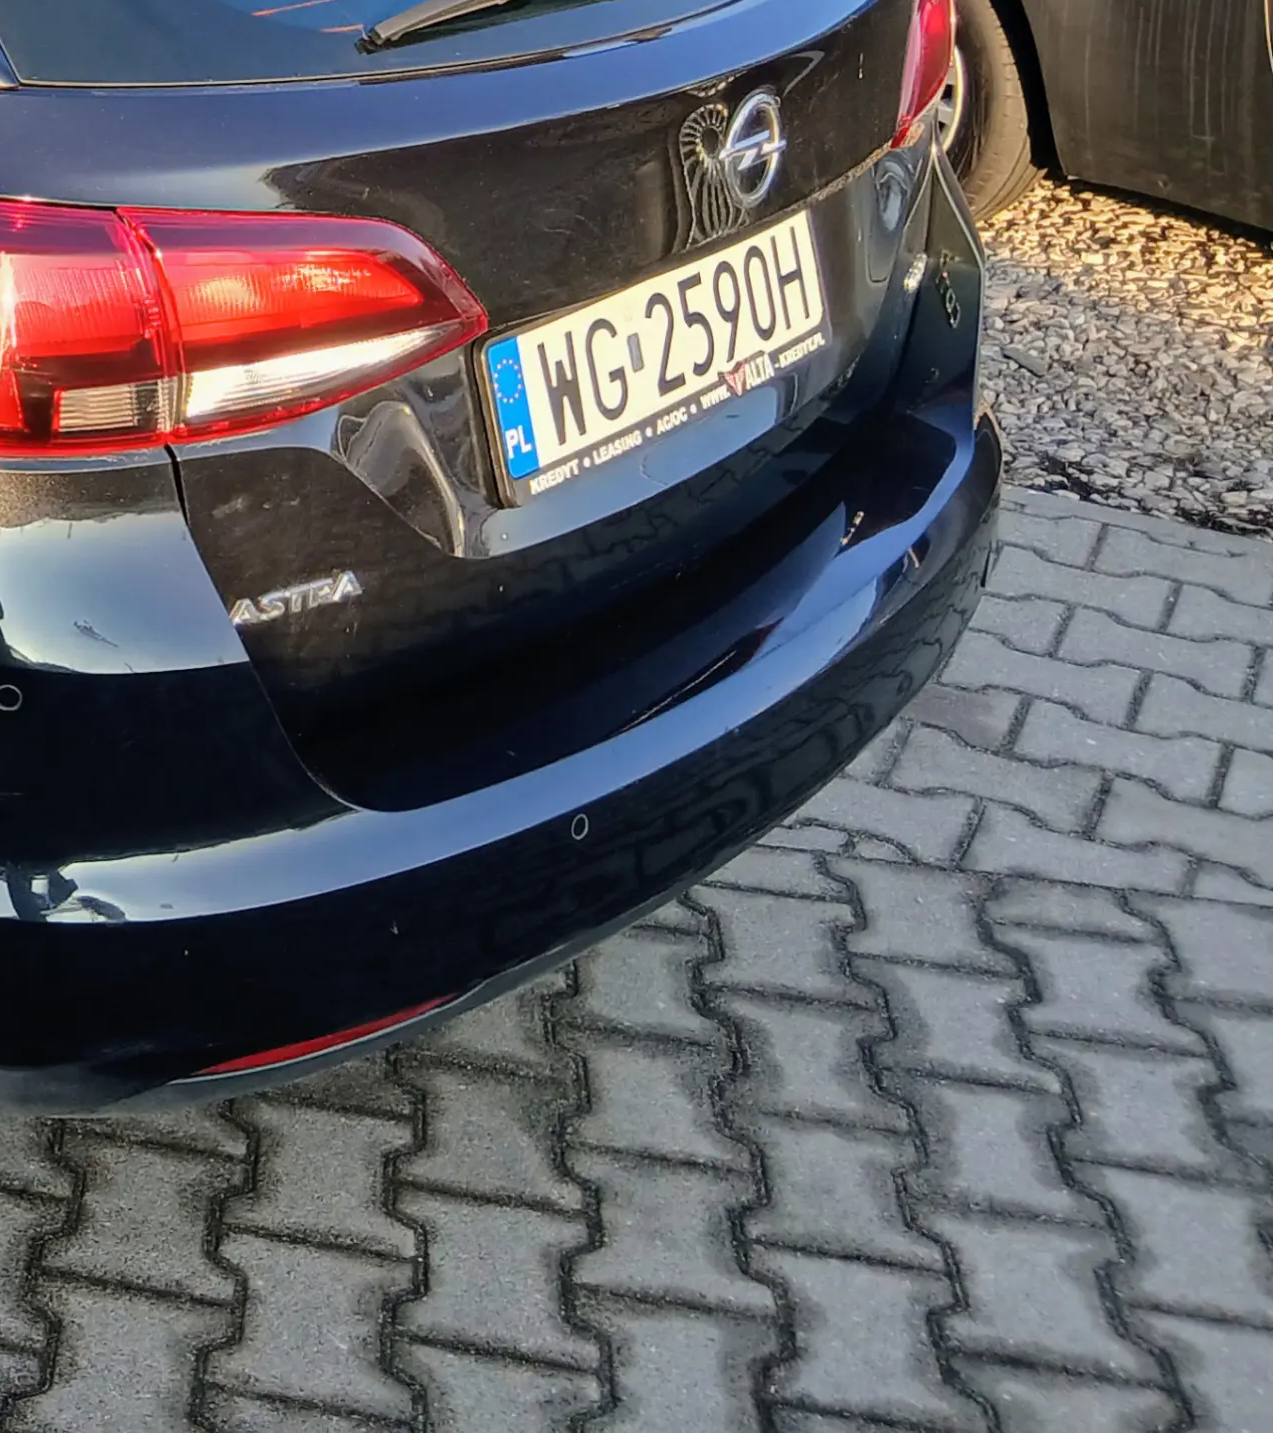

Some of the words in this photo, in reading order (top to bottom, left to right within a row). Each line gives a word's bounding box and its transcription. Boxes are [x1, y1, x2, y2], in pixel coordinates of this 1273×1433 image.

[537, 318, 628, 446] WG
[644, 226, 811, 397] 2590H
[504, 425, 533, 460] PL
[528, 459, 579, 496] KREDYT
[591, 430, 643, 466] LEASING
[229, 569, 363, 627] ASTRA
